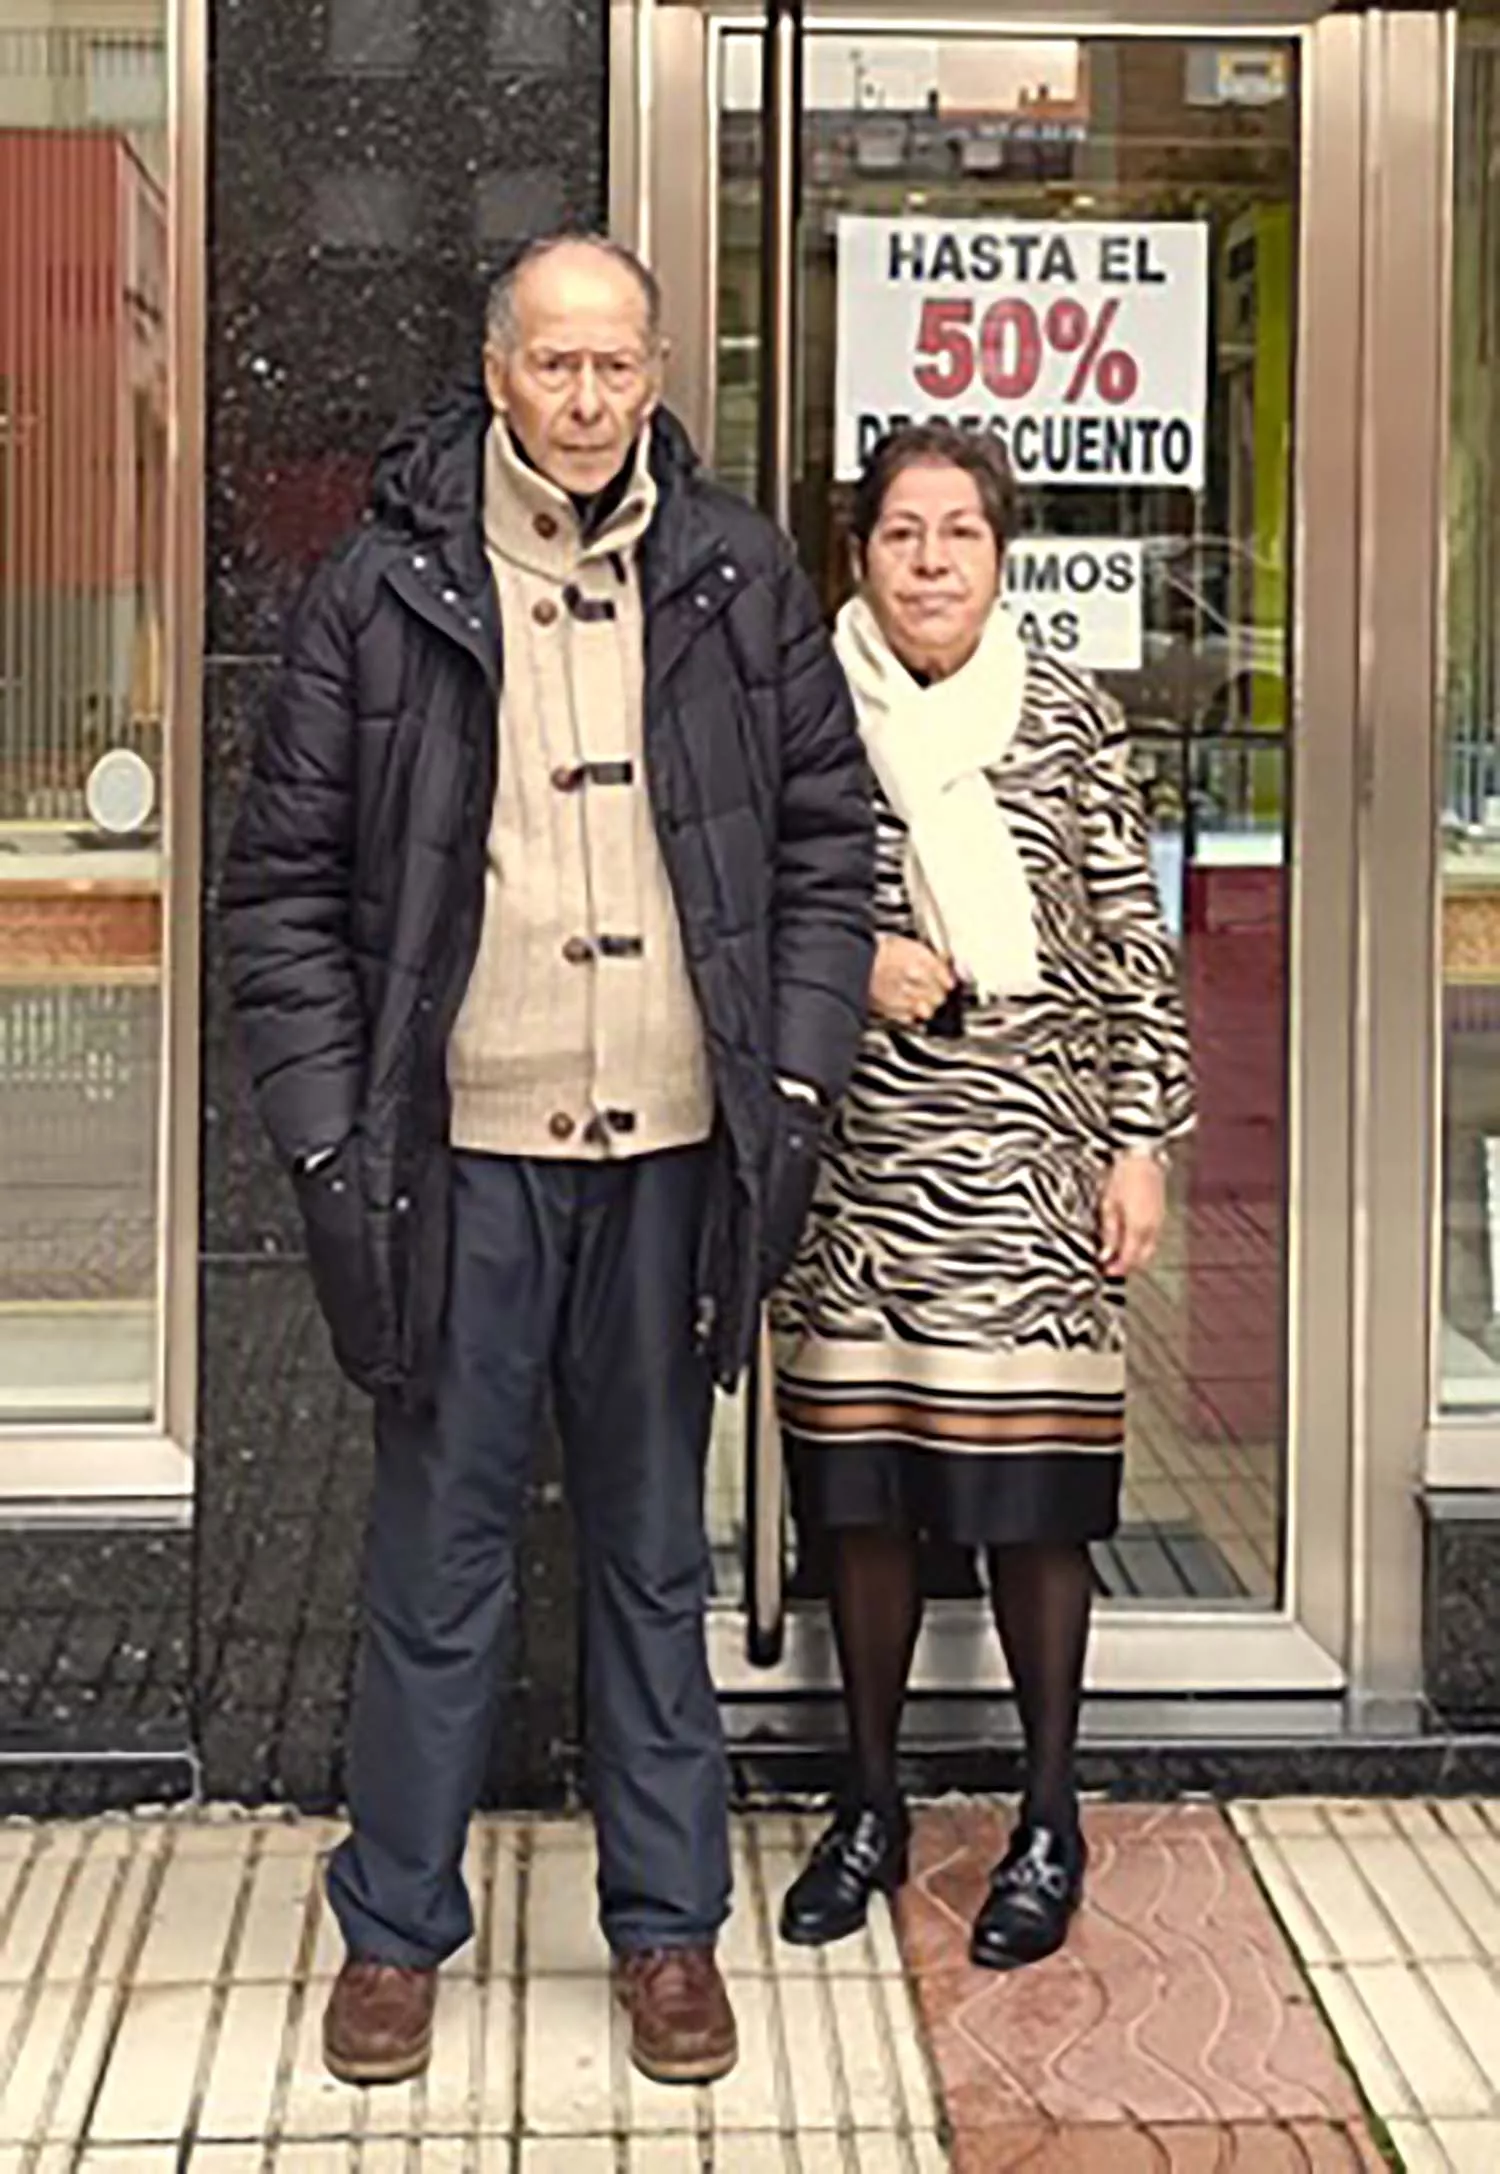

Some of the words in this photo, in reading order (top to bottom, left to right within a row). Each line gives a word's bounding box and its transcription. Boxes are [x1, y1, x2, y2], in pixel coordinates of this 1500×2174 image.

[888, 233, 1076, 283] HASTA
[1099, 235, 1167, 284] EL
[913, 297, 1139, 404] 50%
[857, 413, 912, 469] D
[928, 414, 1193, 475] CUENTO
[1006, 551, 1135, 593] IMOS
[1000, 600, 1080, 652] AS
